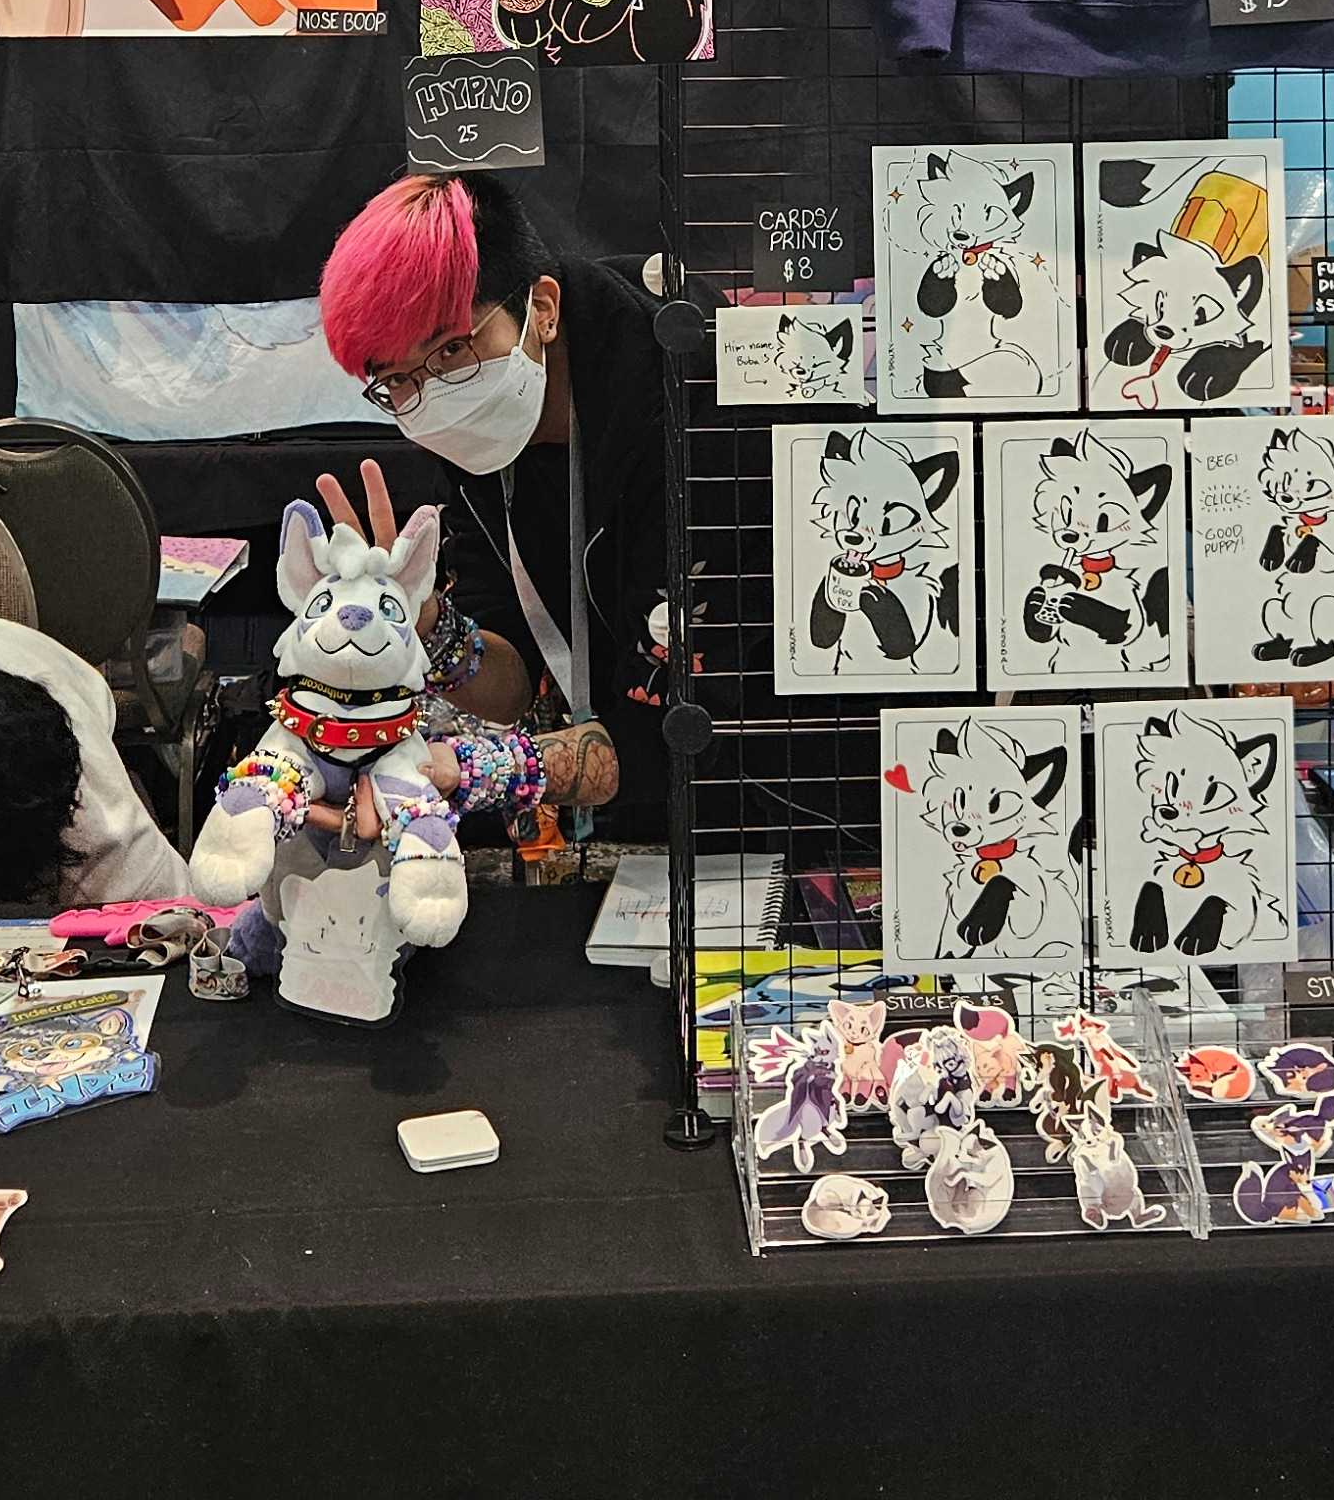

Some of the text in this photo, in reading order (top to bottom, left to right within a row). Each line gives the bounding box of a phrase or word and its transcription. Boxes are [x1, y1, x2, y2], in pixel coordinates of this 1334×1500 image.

[298, 11, 388, 32] NOSE BOOP
[415, 75, 532, 124] HYPNO
[457, 124, 479, 144] 25
[759, 207, 839, 231] CARDS/
[770, 229, 844, 251] PRINTS
[783, 256, 814, 283] $8
[1207, 455, 1238, 471] BEG!
[1204, 492, 1242, 508] CLICK
[1204, 524, 1242, 540] GOOD
[1204, 537, 1244, 557] PUPPY!
[298, 677, 353, 703] Anthrocon
[10, 991, 120, 1023] Indecraftable
